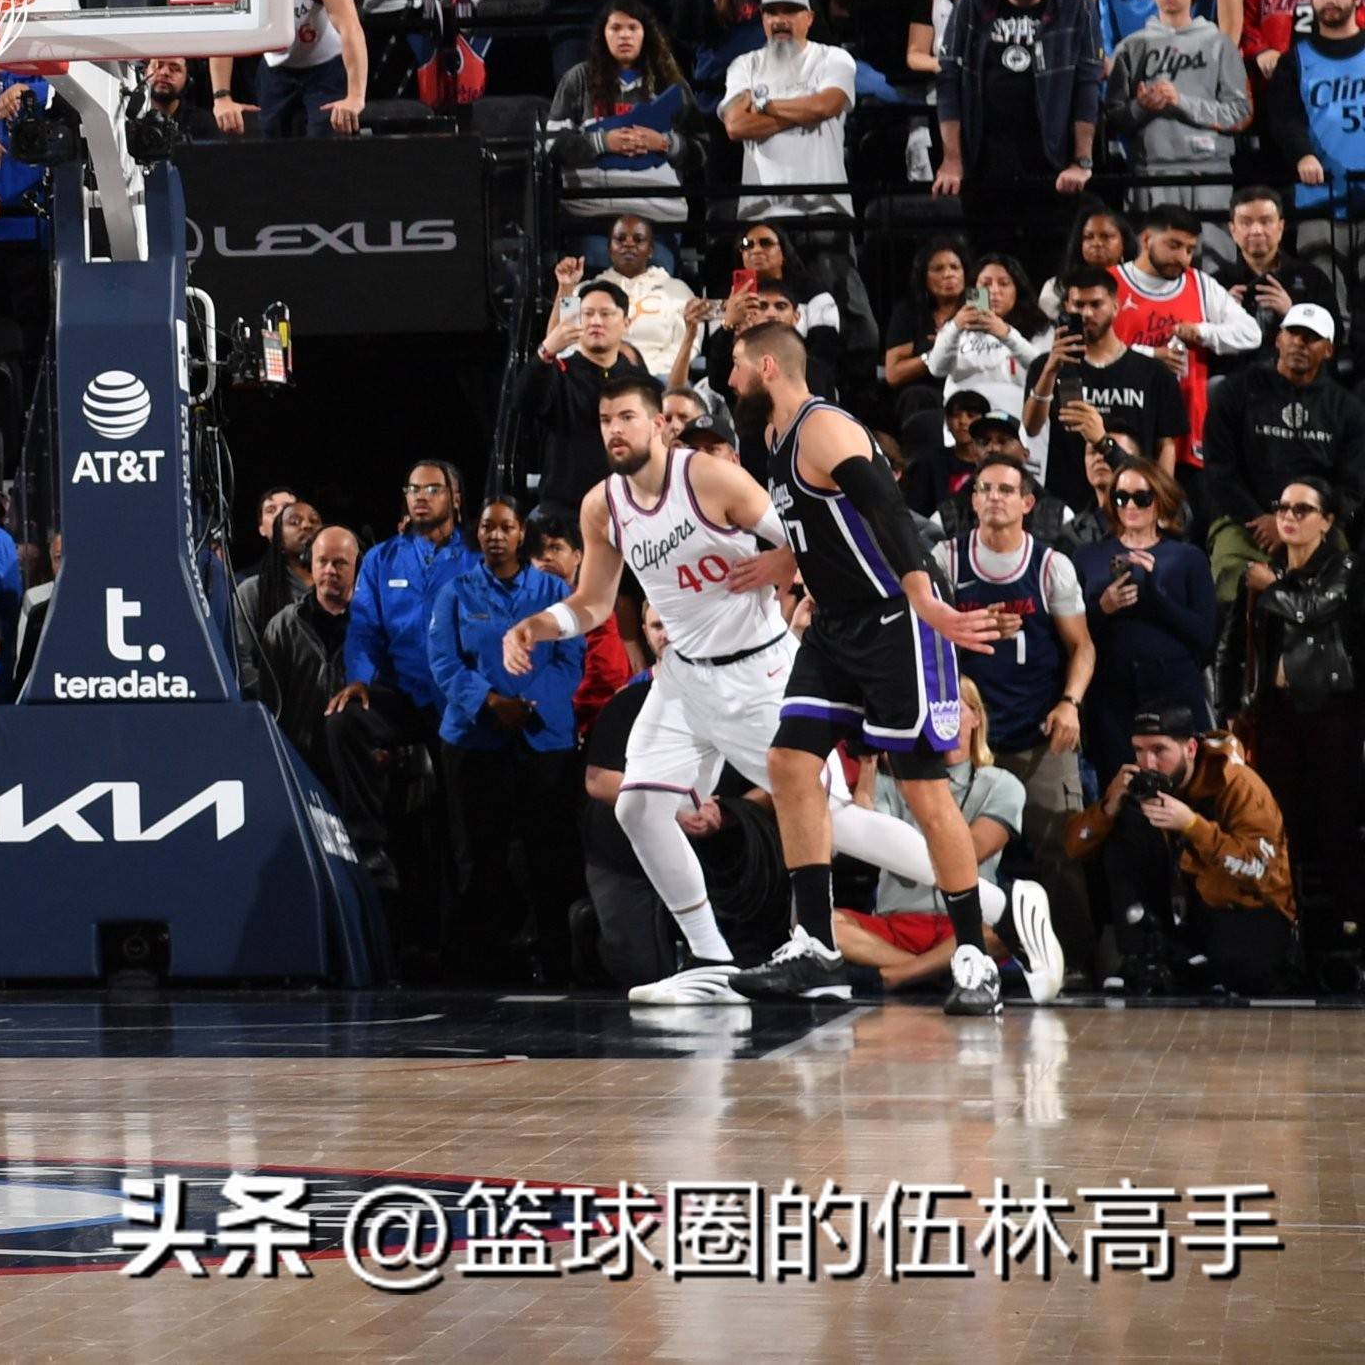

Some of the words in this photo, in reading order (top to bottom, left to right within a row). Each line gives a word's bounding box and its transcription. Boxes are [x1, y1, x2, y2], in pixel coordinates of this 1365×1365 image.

[1293, 3, 1314, 34] 2
[1143, 45, 1207, 82] Clips
[214, 219, 457, 256] LEXUS
[1082, 385, 1146, 410] LMAIN
[71, 449, 166, 484] AT&T
[630, 519, 697, 572] Clippers
[676, 554, 730, 594] 40
[53, 669, 197, 700] teradata.
